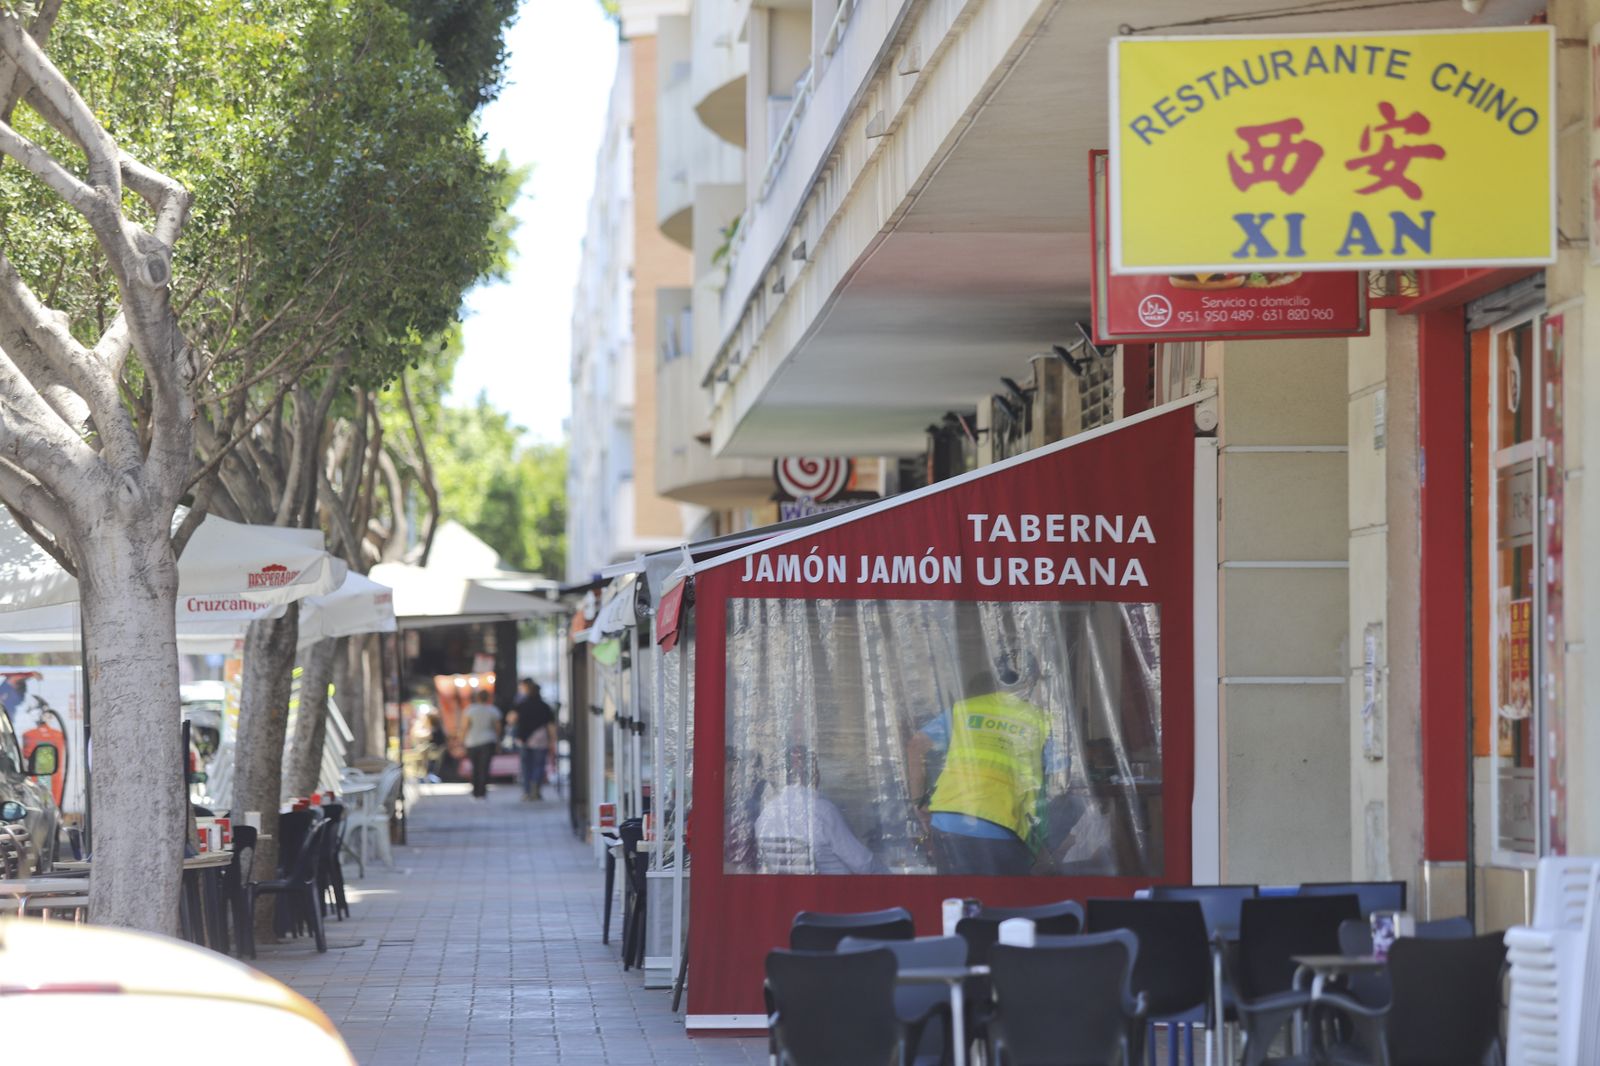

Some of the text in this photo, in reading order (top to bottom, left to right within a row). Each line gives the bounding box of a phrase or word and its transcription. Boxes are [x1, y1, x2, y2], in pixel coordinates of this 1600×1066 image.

[1129, 45, 1412, 145] RESTAURANTE
[1431, 62, 1539, 136] CHINO
[1227, 101, 1446, 200] 西安
[1232, 211, 1436, 259] XI AN
[1177, 308, 1334, 322] 951 950 489 631 820 960
[1201, 296, 1246, 309] Servicio
[1260, 295, 1311, 308] domicilio
[967, 513, 1157, 545] TABERNA
[741, 545, 1150, 587] JAMÓN JAMÓN URBANA
[187, 598, 269, 612] Cruzcampo
